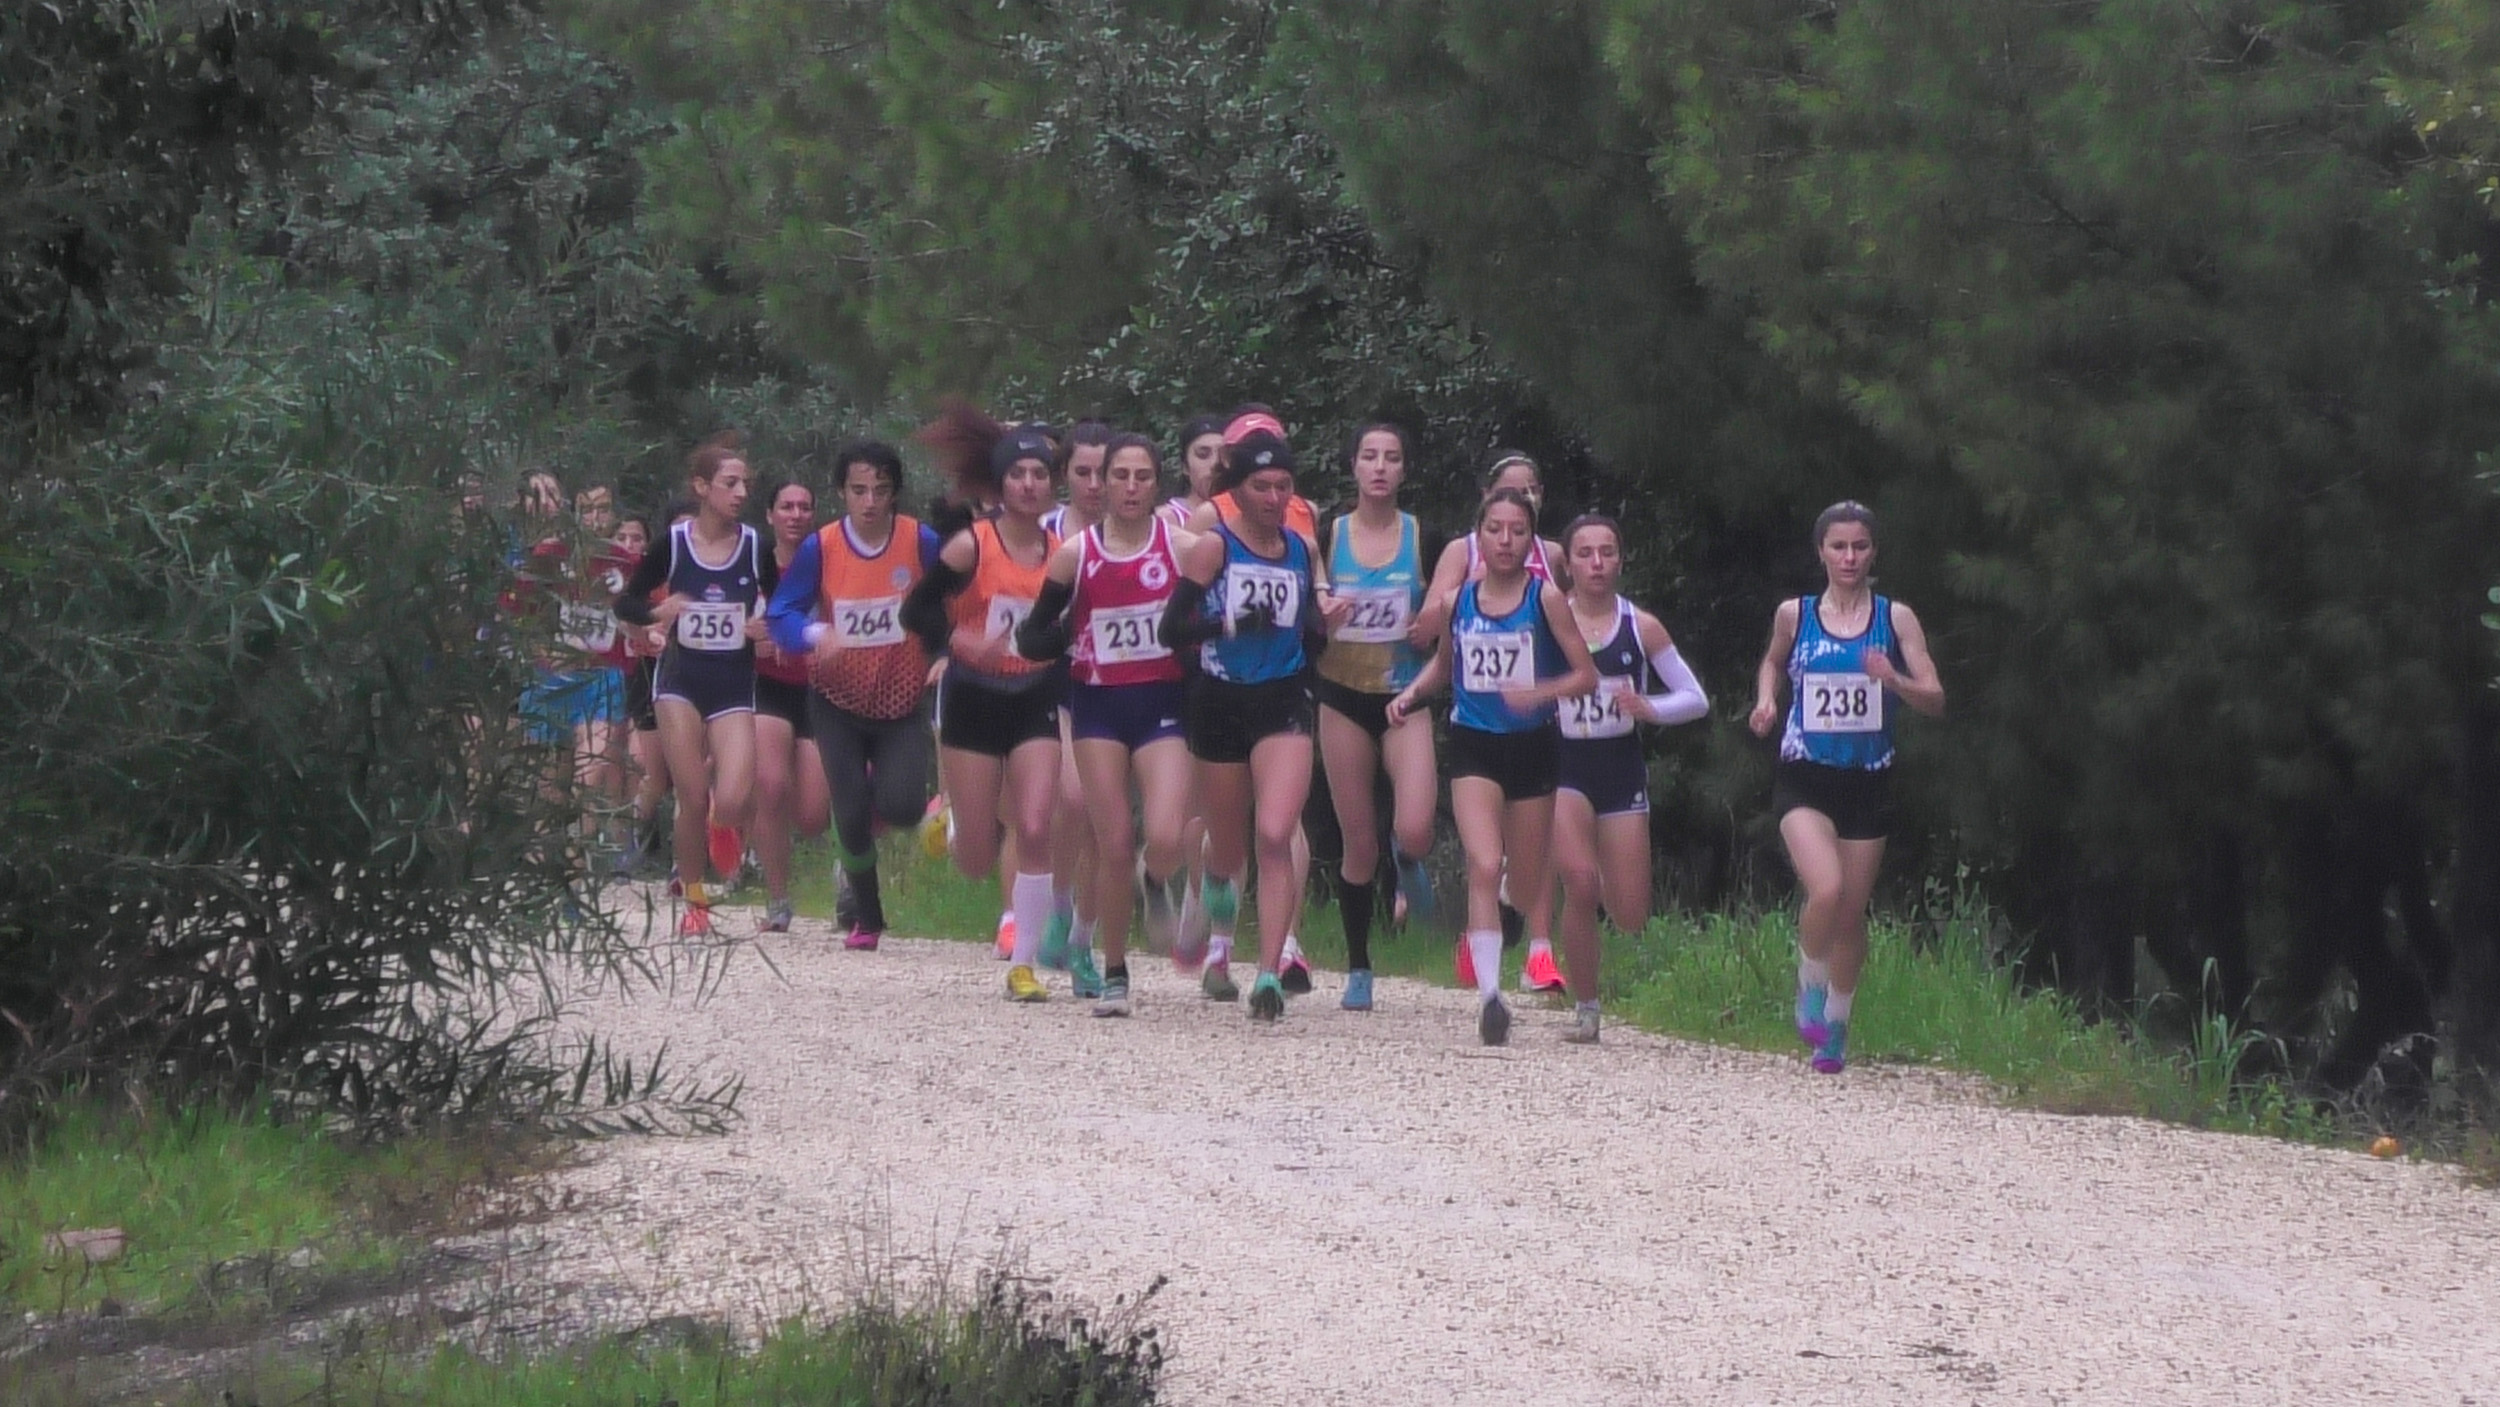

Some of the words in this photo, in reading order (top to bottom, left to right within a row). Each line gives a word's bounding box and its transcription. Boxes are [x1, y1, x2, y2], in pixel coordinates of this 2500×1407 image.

[1240, 579, 1288, 612] 239
[689, 613, 734, 639] 256
[844, 608, 893, 636] 264
[1346, 600, 1396, 629] 226
[1105, 617, 1155, 649] 231
[1470, 647, 1520, 678] 237
[1815, 688, 1868, 718] 238
